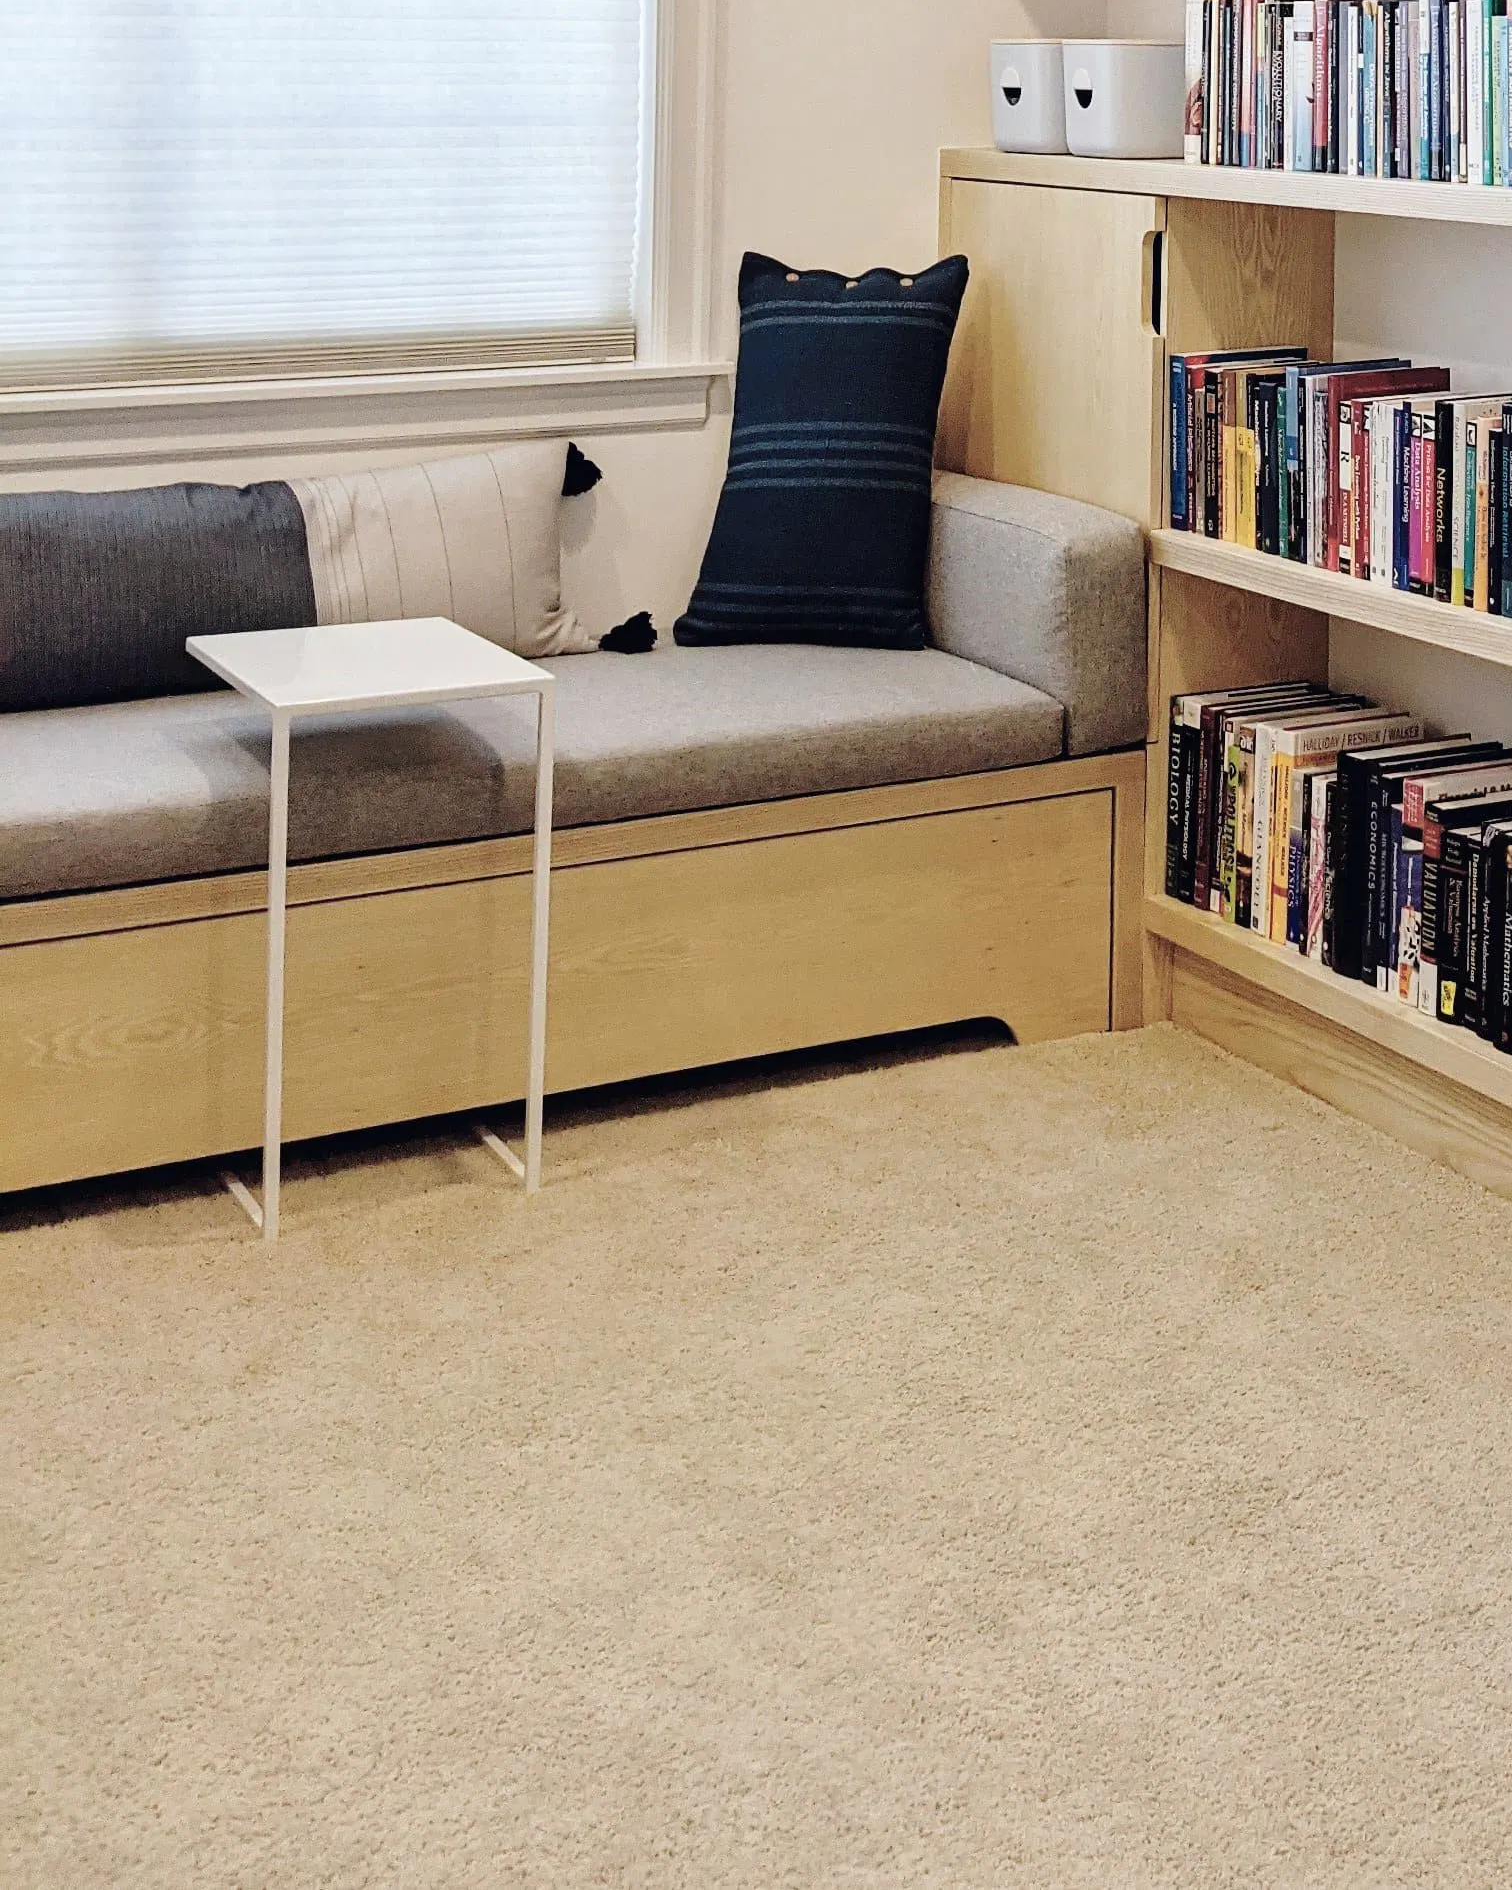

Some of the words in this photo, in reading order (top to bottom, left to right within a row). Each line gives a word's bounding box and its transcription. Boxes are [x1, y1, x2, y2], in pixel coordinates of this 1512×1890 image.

[1341, 451, 1350, 463] R
[1403, 447, 1411, 484] Machine
[1402, 486, 1410, 523] Learning
[1436, 468, 1446, 543] Networks
[1169, 732, 1181, 826] BIOLOGY
[1287, 845, 1297, 908] PHYSICS
[1367, 801, 1378, 890] ECONOMICS
[1422, 862, 1437, 950] VALUATION
